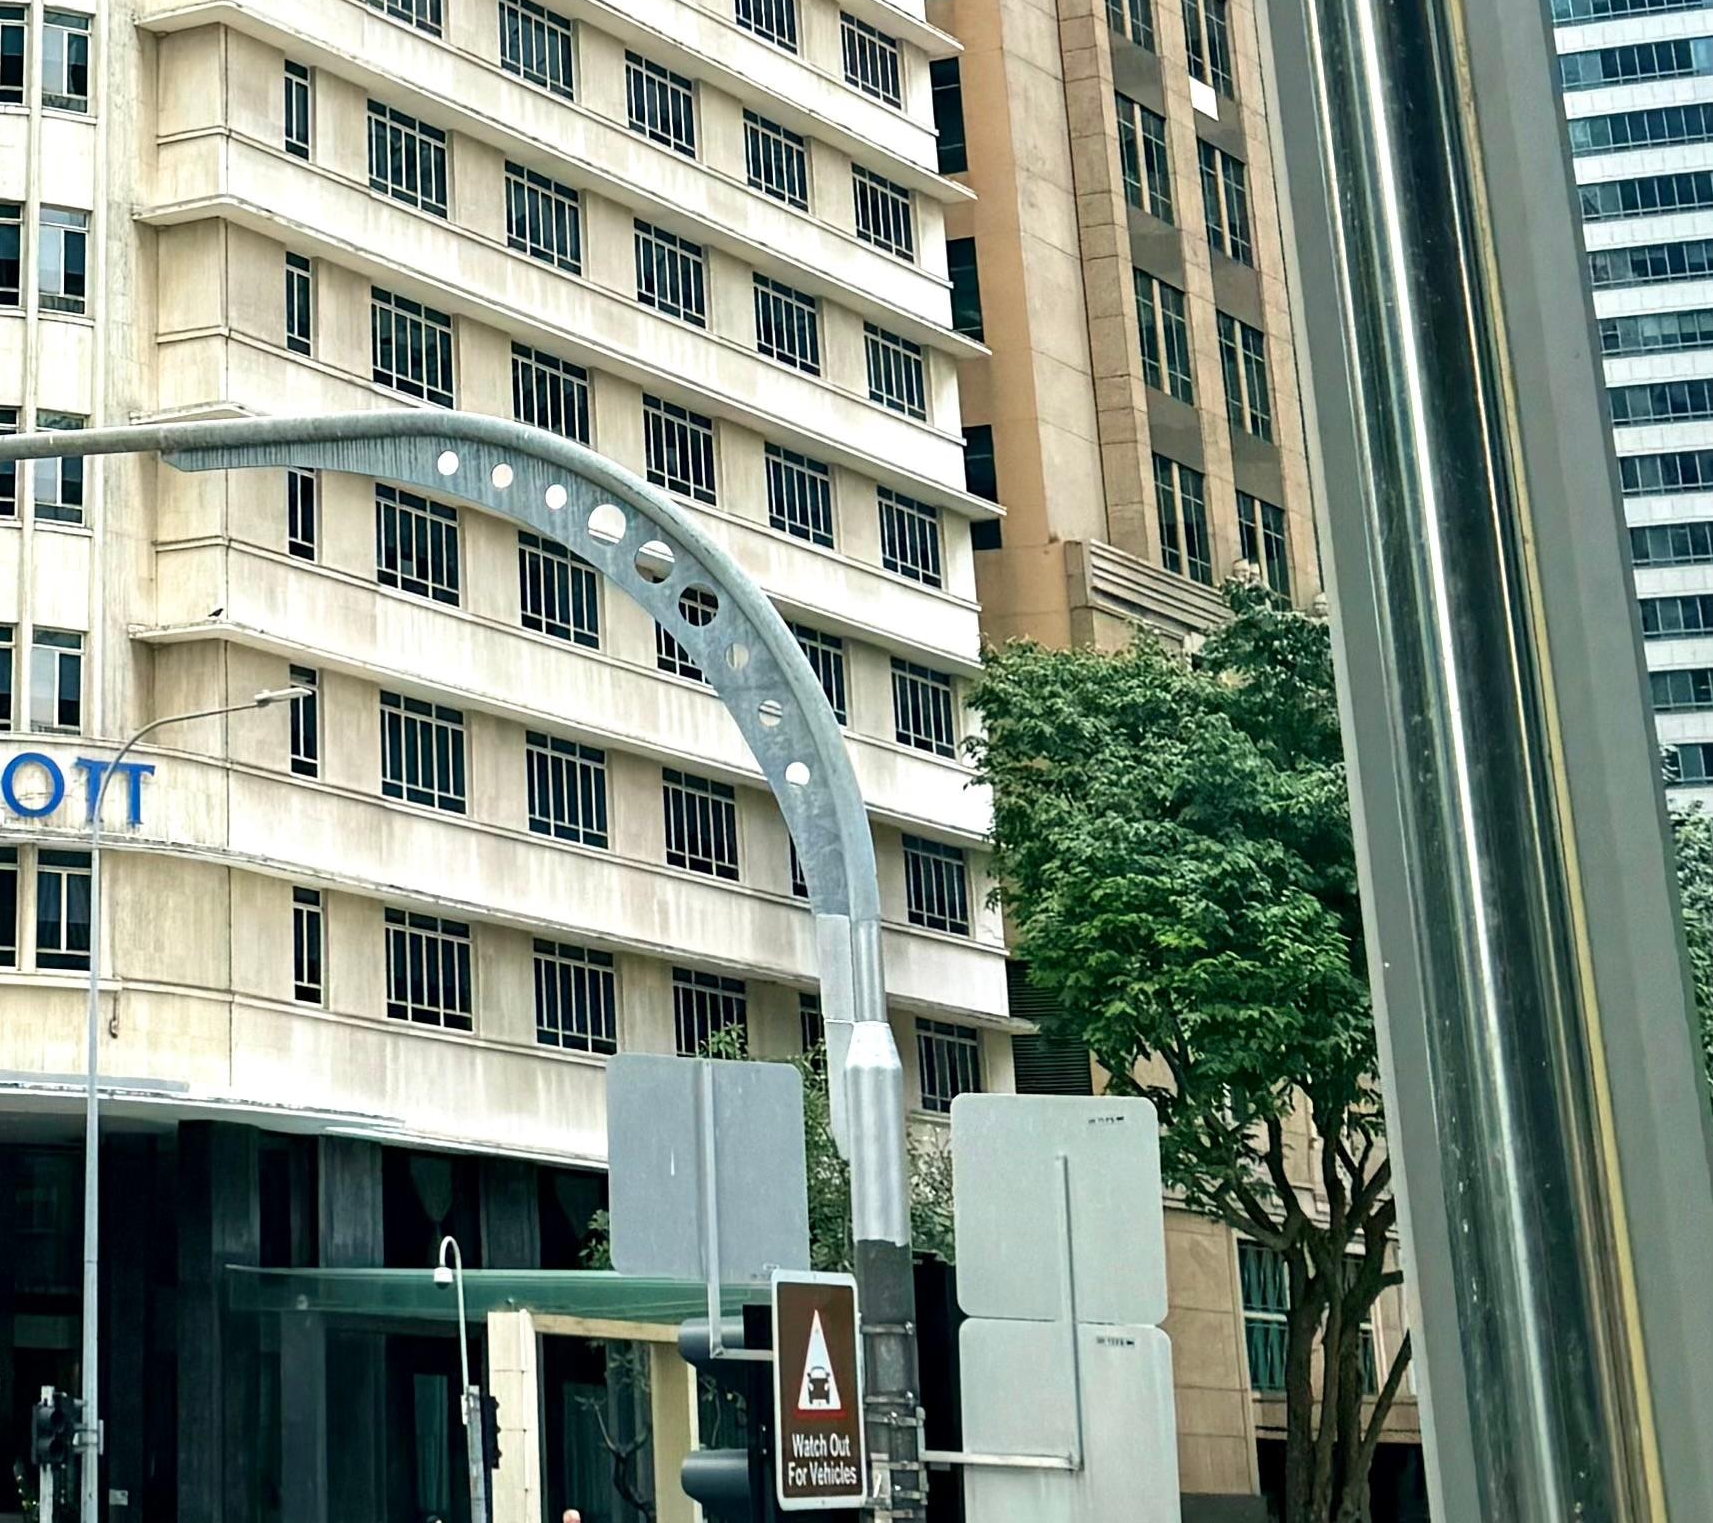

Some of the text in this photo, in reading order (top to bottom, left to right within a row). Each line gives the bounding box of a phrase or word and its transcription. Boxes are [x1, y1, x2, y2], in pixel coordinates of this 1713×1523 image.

[792, 1433, 851, 1458] Watch Out
[788, 1461, 857, 1486] For Vehicles
